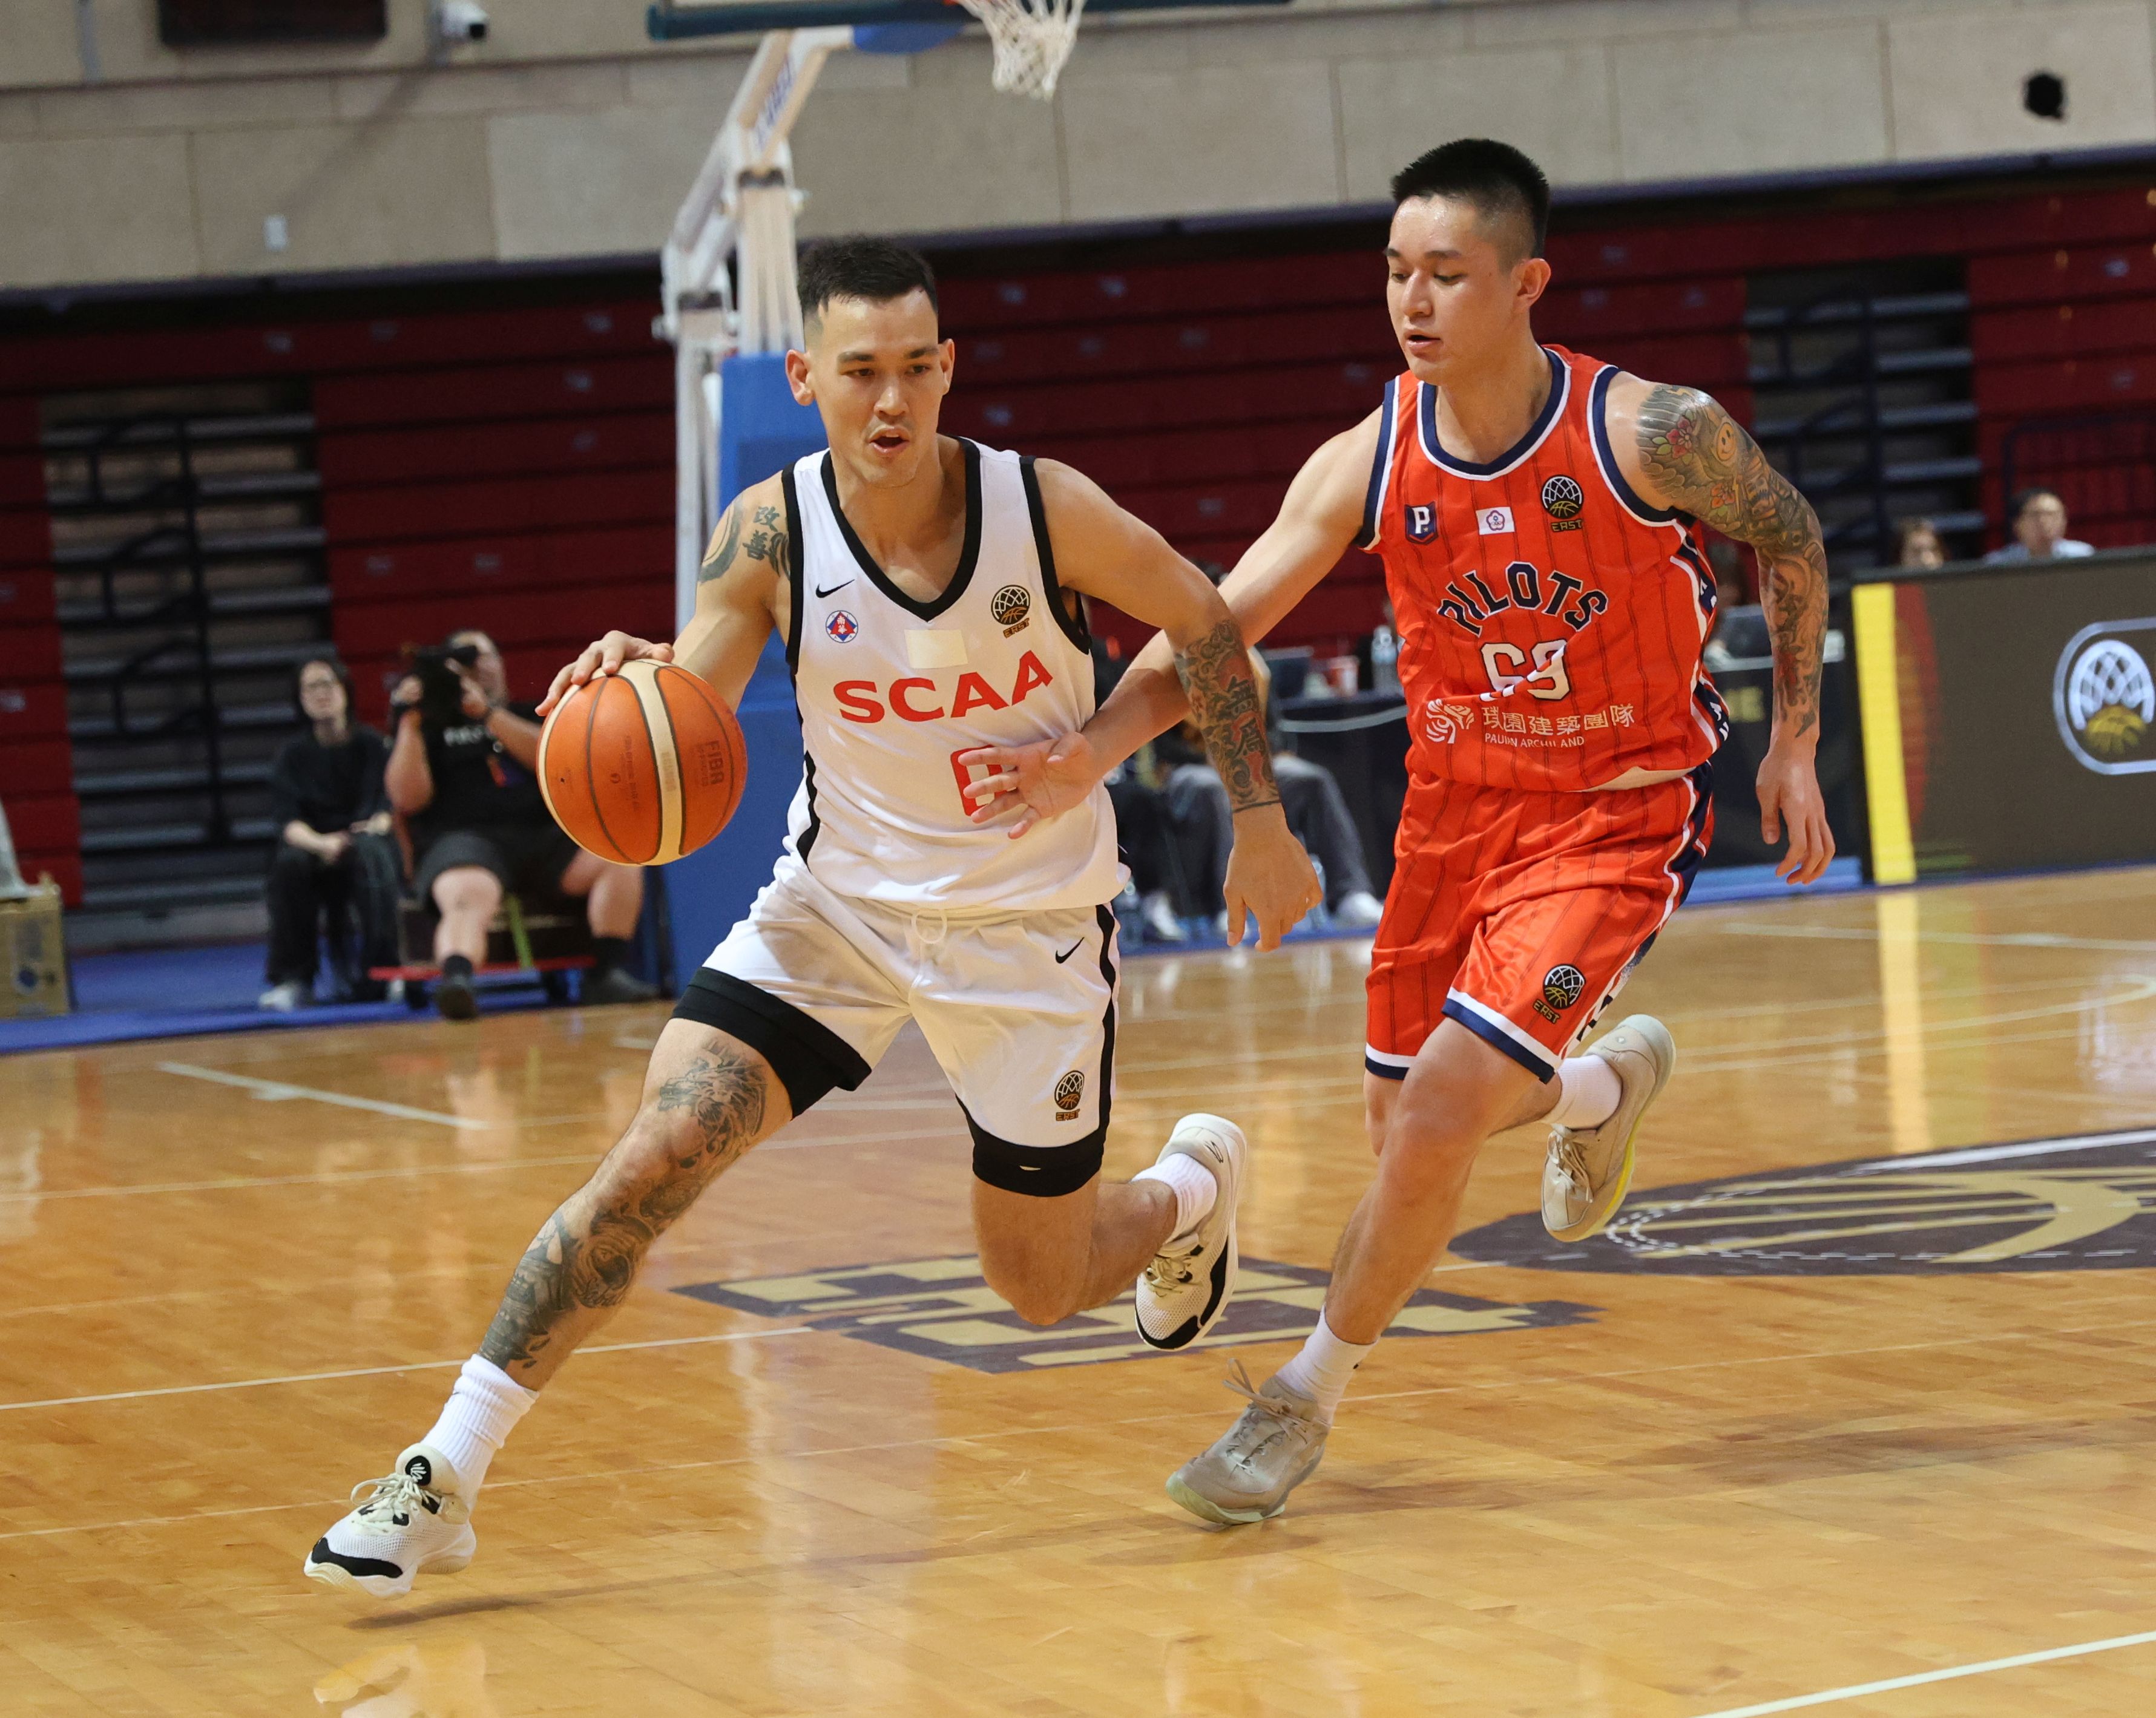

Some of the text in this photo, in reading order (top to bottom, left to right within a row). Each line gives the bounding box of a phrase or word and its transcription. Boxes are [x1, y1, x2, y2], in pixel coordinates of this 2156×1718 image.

[1412, 507, 1430, 534] P
[1551, 519, 1583, 533] EAST
[1437, 561, 1608, 638] PILOTS
[1003, 617, 1030, 639] EAST
[833, 650, 1053, 723] SCAA
[1533, 998, 1561, 1024] EAST
[1056, 1109, 1080, 1121] EAST
